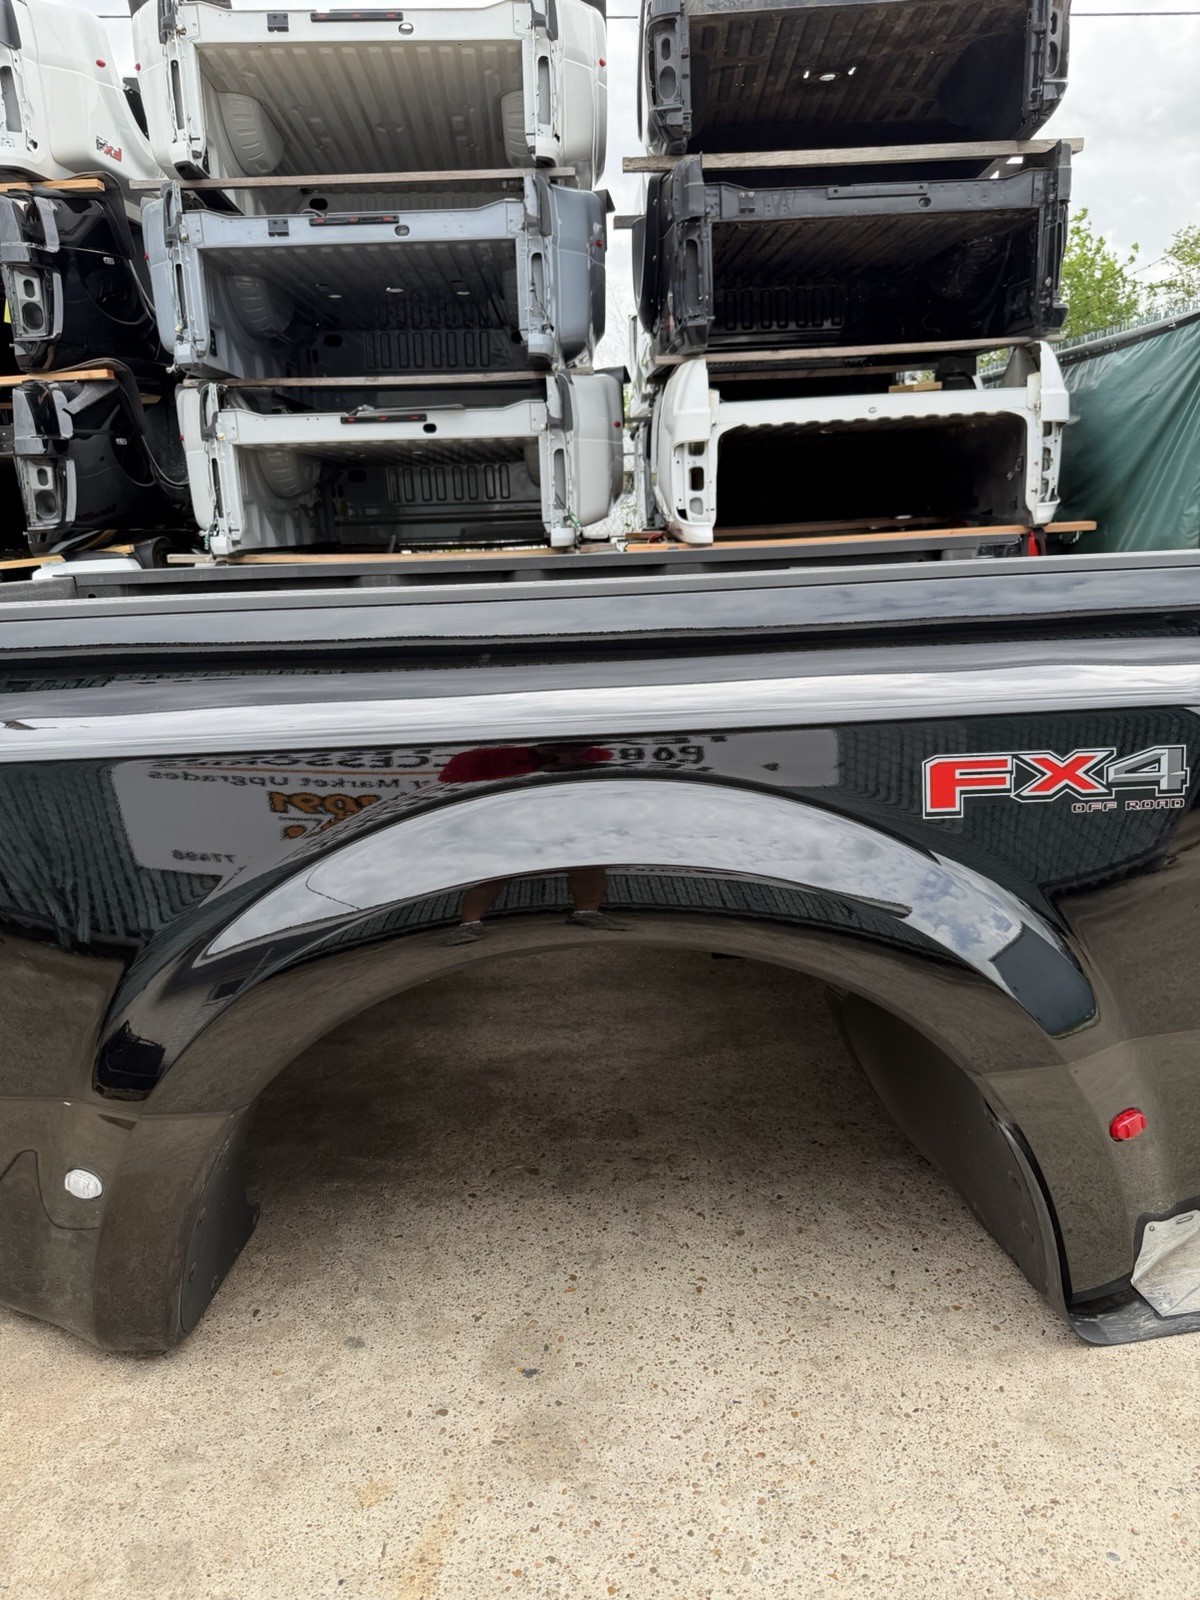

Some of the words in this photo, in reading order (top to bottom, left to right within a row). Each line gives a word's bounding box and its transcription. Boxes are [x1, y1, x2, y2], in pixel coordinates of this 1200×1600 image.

[922, 744, 1190, 819] FX4
[1071, 801, 1117, 813] OFF
[1124, 798, 1185, 811] ROAD
